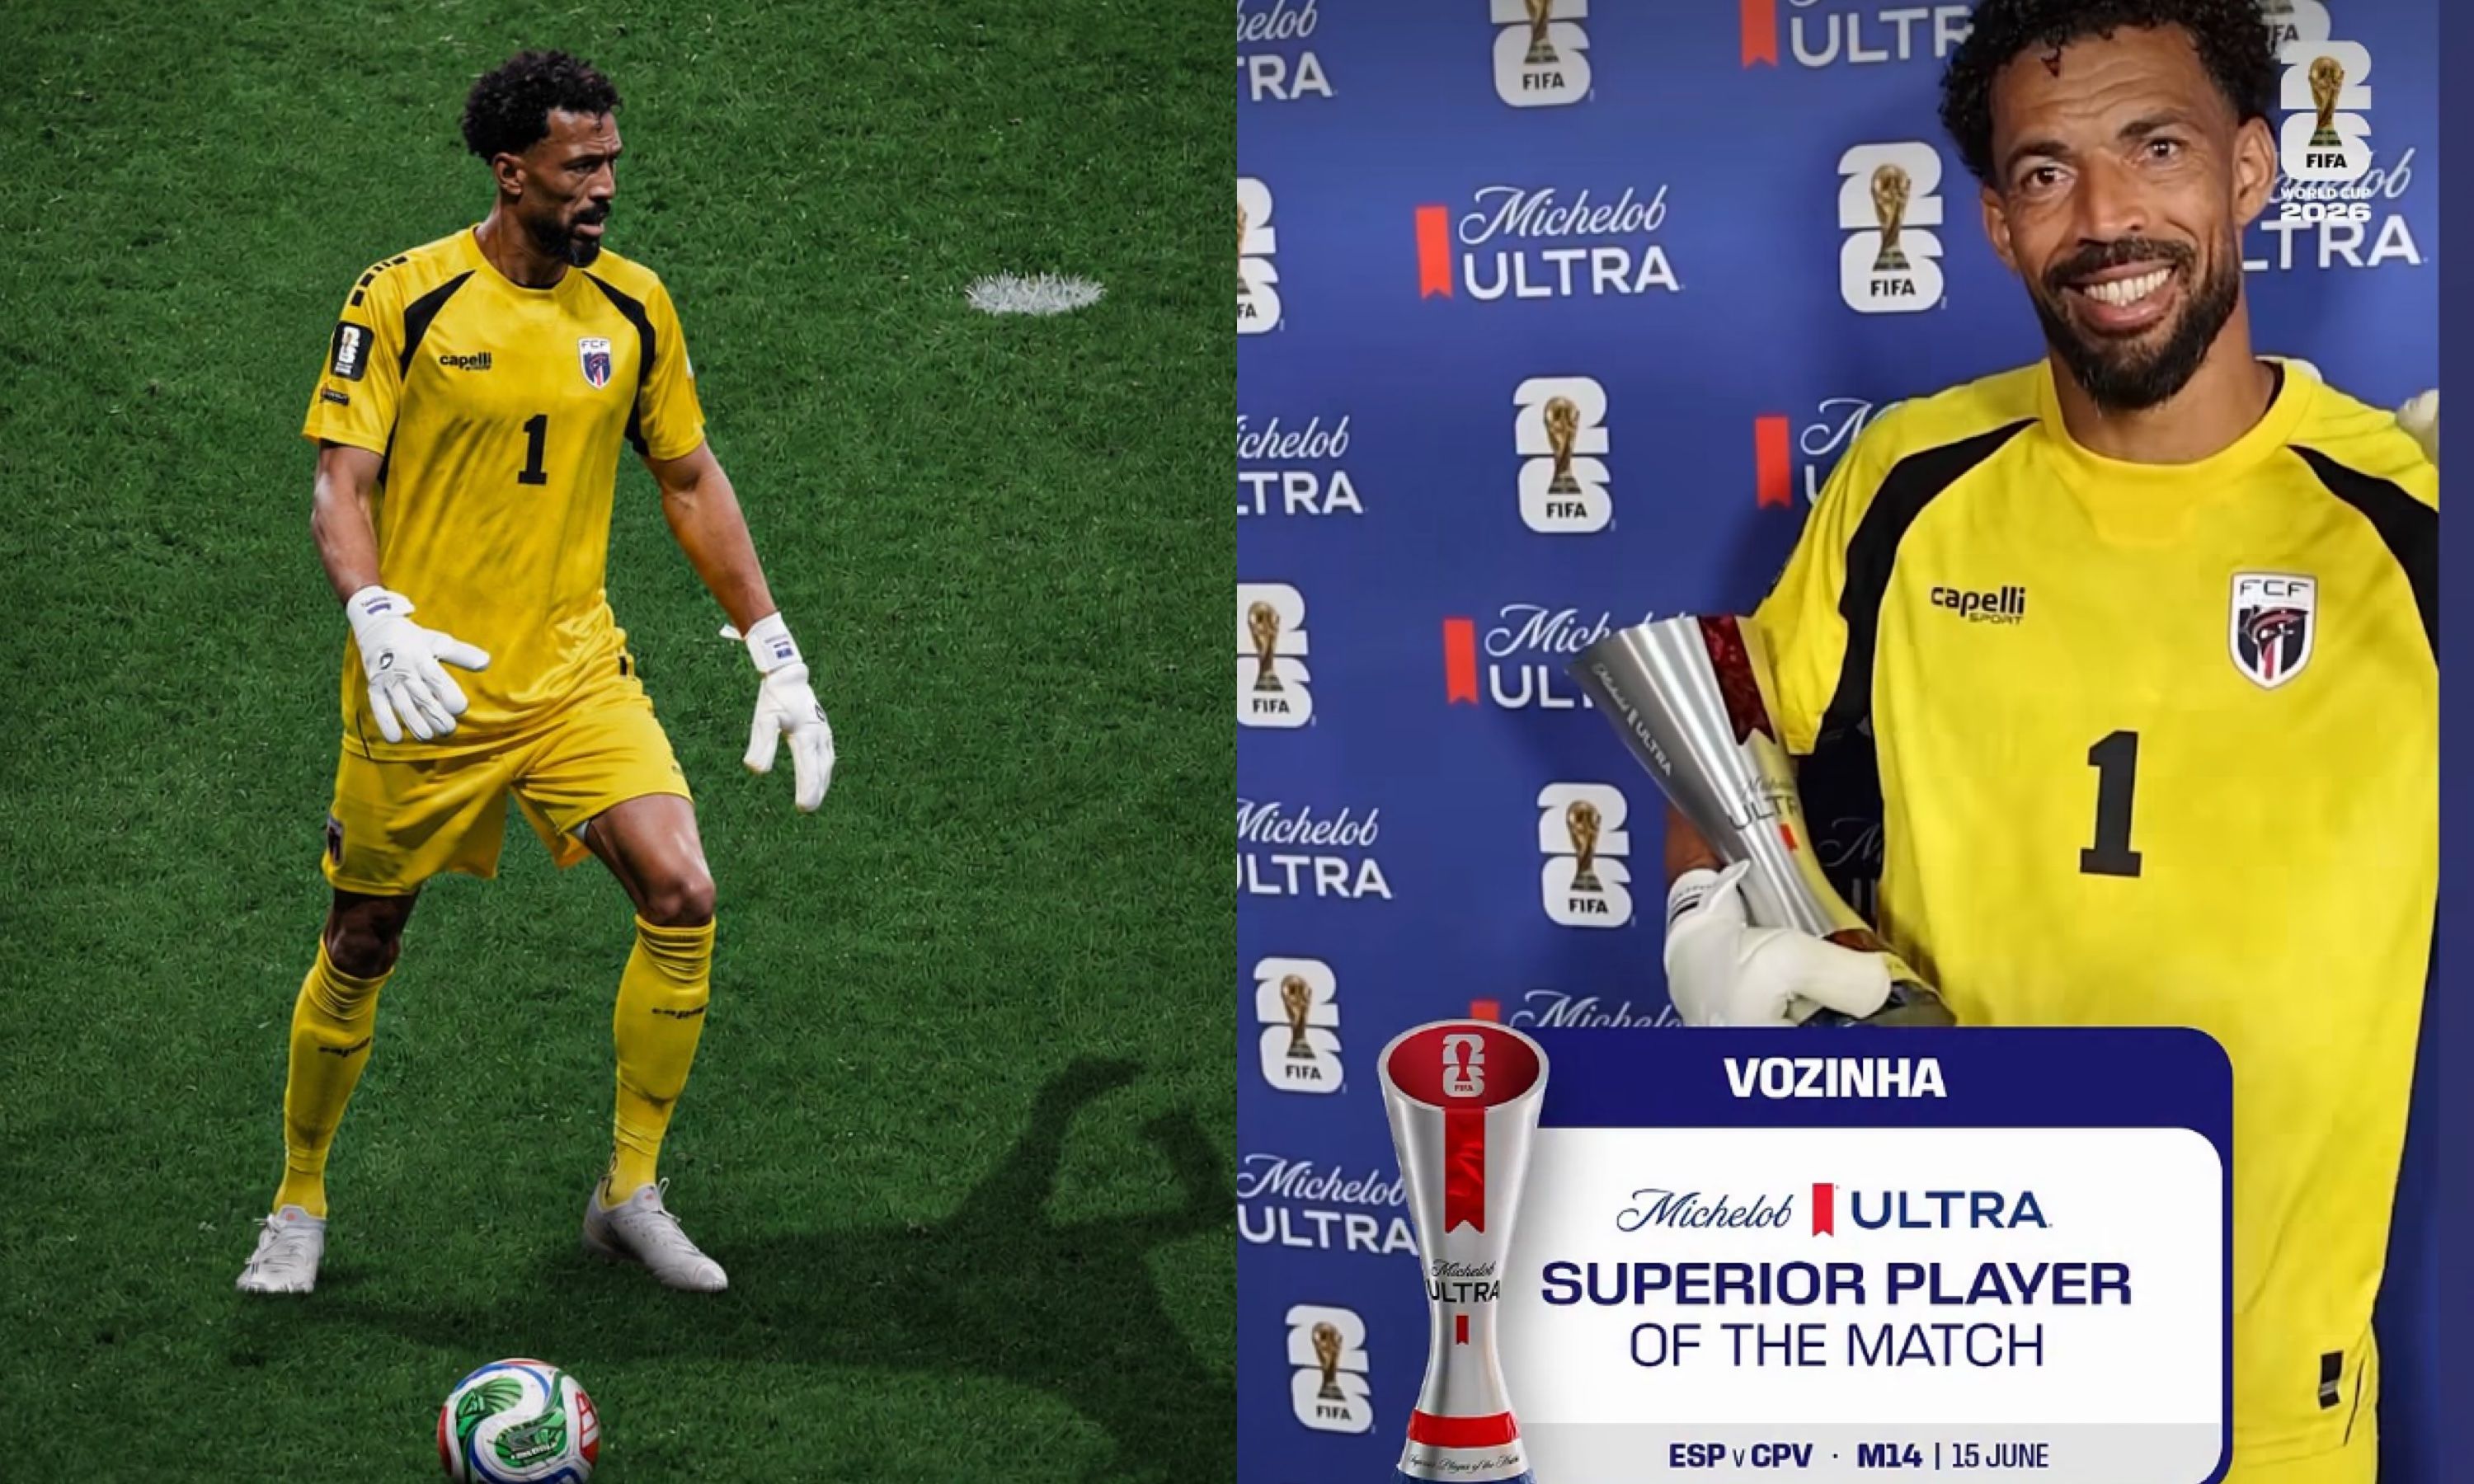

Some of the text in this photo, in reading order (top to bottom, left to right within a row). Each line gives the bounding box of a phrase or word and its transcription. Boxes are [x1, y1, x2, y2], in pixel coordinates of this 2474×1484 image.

[1790, 4, 1975, 68] ULTR
[1522, 72, 1565, 91] FIFA
[1459, 185, 1668, 245] Michelob
[1463, 245, 1679, 300] ULTRA
[1870, 279, 1916, 297] FIFA
[440, 351, 492, 370] capelli
[517, 414, 548, 485] 1
[1546, 502, 1587, 519] FIFA
[2239, 579, 2309, 597] FCF
[1931, 586, 2025, 618] capelli
[1253, 697, 1290, 714] FIFA
[2079, 730, 2142, 878] 1
[1569, 898, 1609, 914] FIFA
[1286, 1065, 1322, 1081] FIFA
[1237, 1203, 1420, 1256] ULTRA
[1316, 1404, 1352, 1421] FIFA
